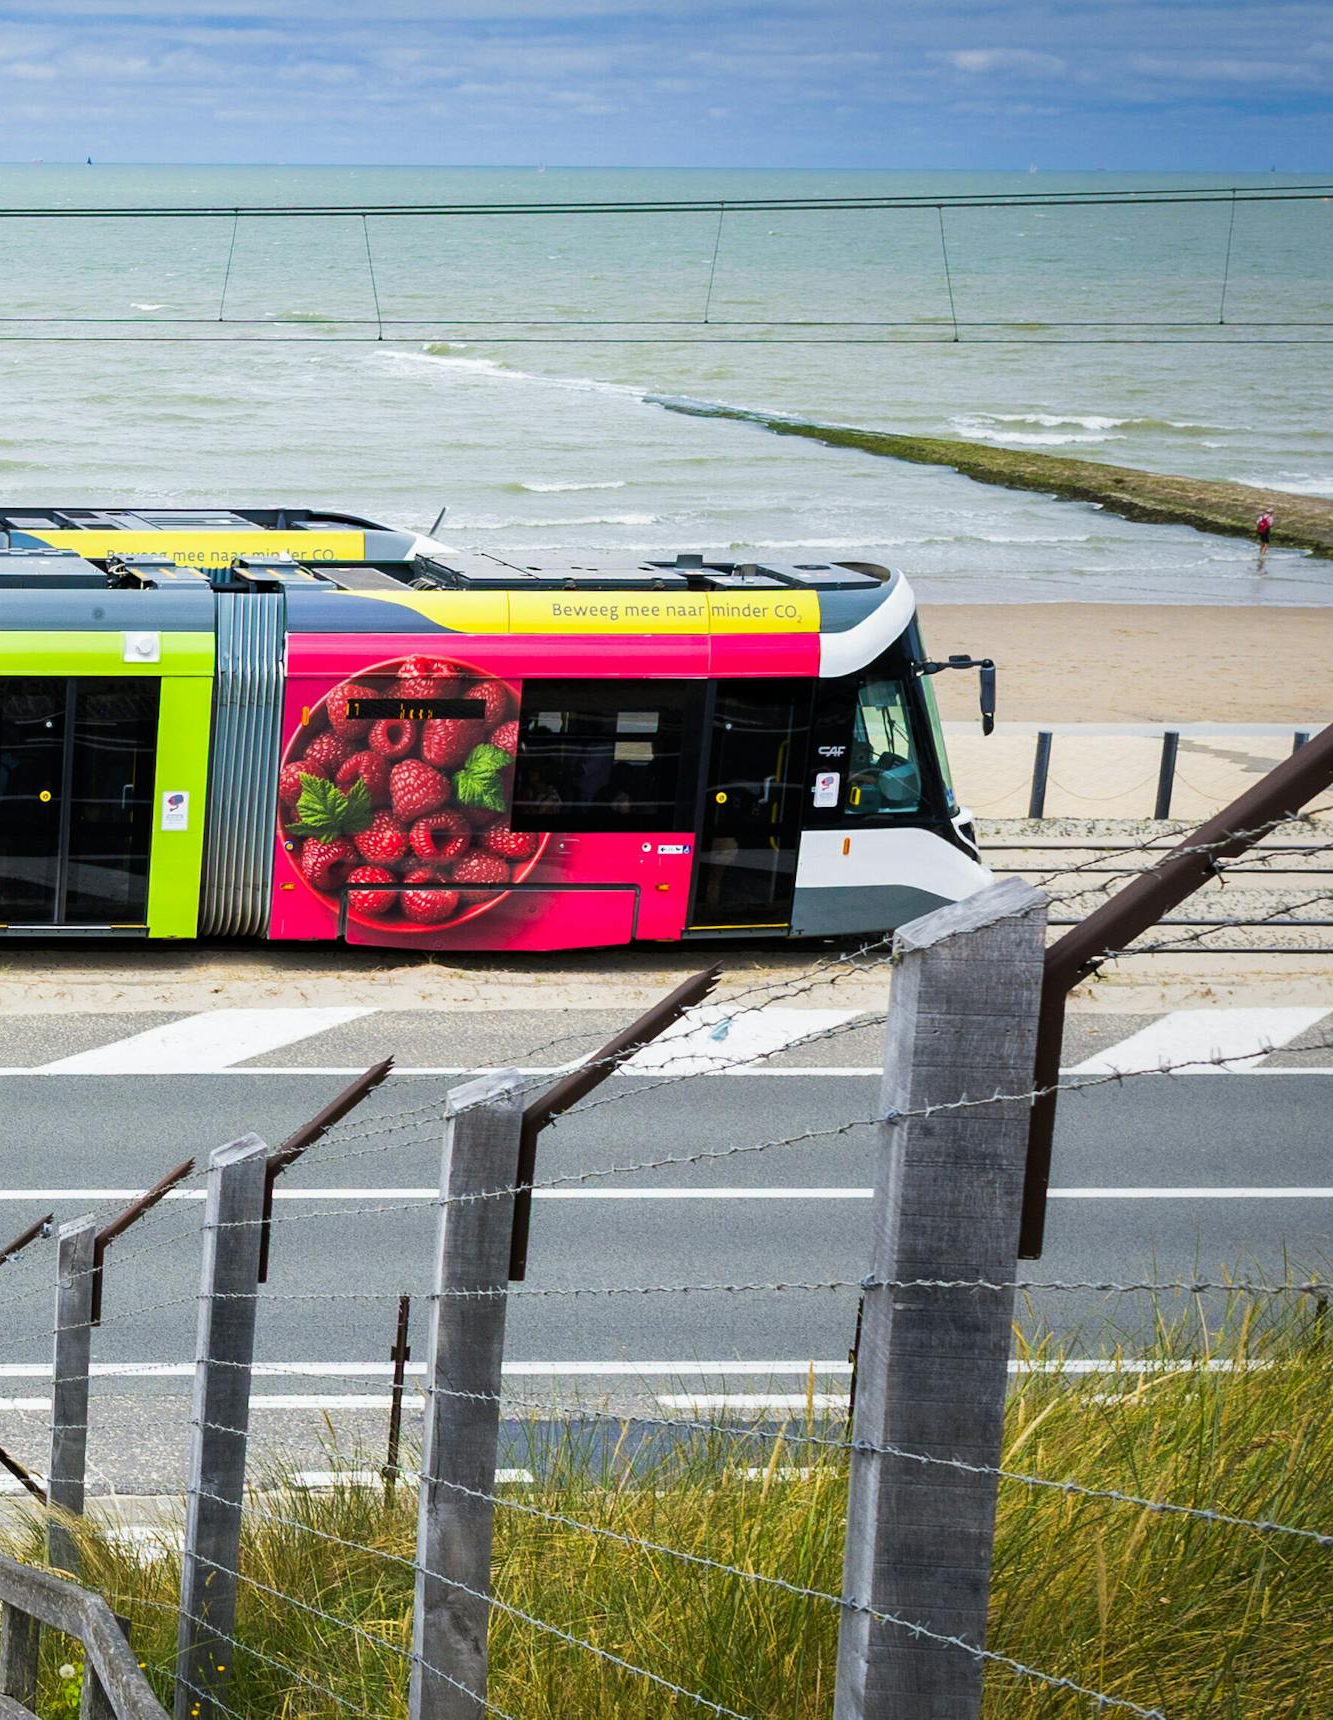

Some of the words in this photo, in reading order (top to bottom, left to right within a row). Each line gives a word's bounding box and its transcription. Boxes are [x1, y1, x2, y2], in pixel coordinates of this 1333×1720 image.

[173, 551, 205, 562] mee
[552, 603, 619, 621] Beweeg
[625, 605, 660, 617] mee
[666, 605, 705, 617] naar
[711, 602, 769, 618] minder
[818, 745, 846, 757] CAF
